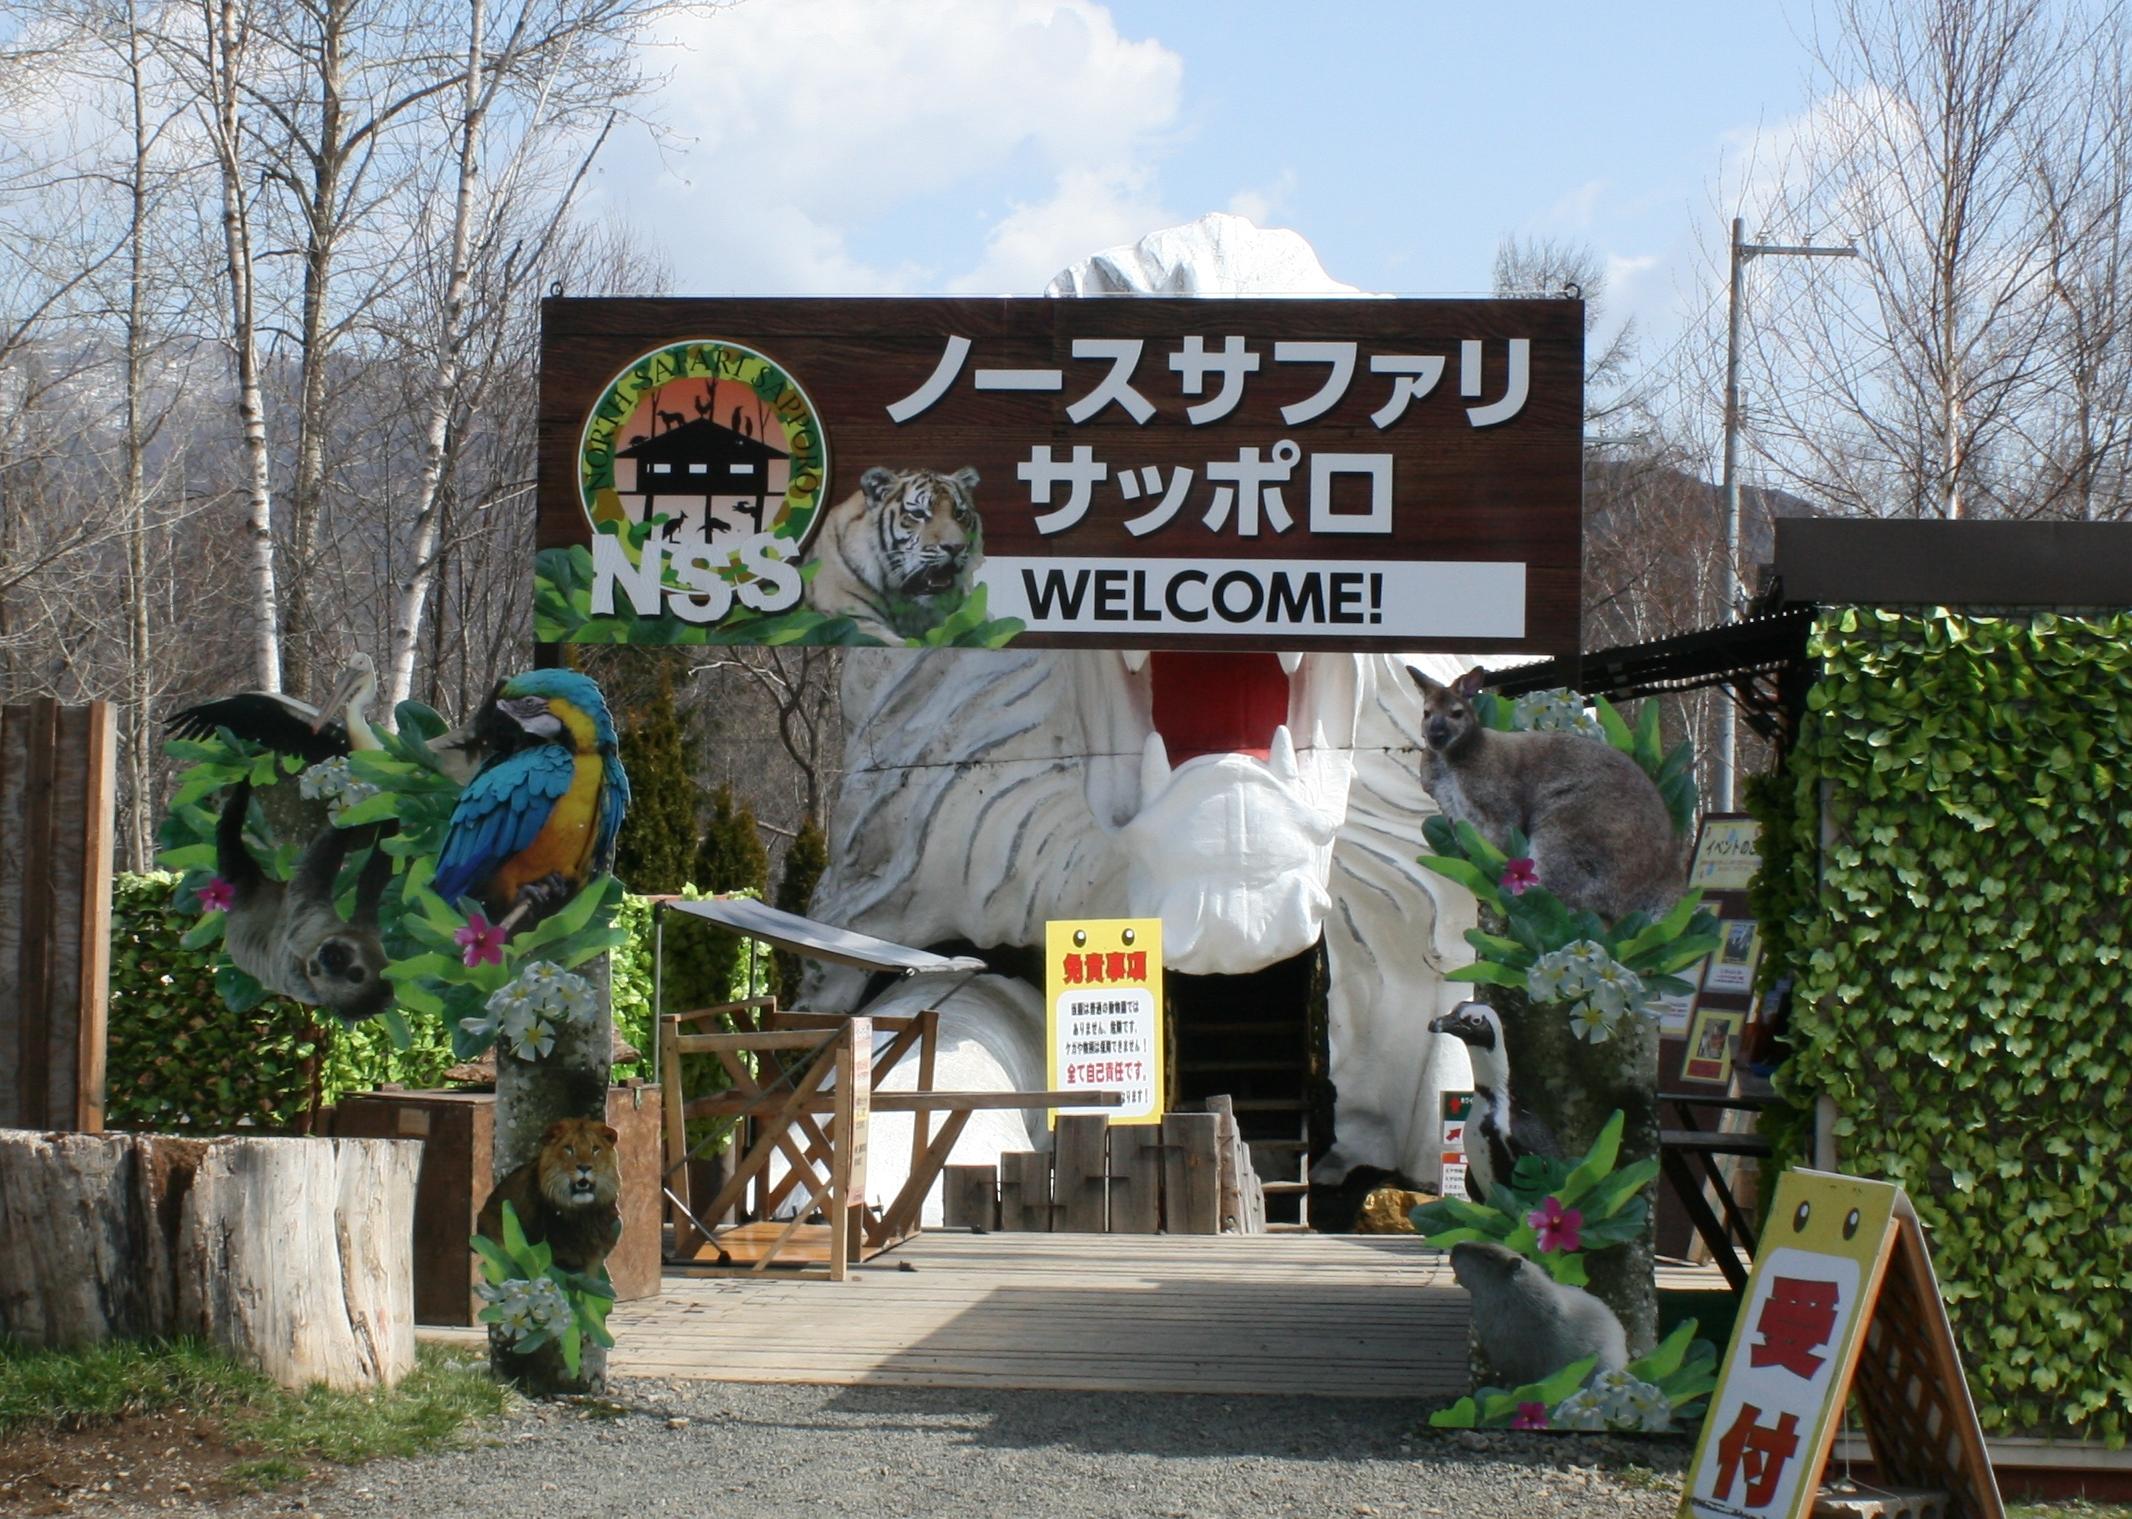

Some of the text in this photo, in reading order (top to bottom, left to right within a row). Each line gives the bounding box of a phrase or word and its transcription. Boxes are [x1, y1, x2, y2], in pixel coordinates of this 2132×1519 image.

[585, 347, 819, 495] NORTH SAFARI SAPPORO
[886, 334, 1531, 429] ノースサファリ
[1017, 439, 1393, 536] サッポロ
[590, 532, 801, 623] NSS
[1021, 568, 1384, 625] WELCOME!
[1063, 951, 1148, 985] 免責事項
[1712, 1275, 1840, 1509] 受付
